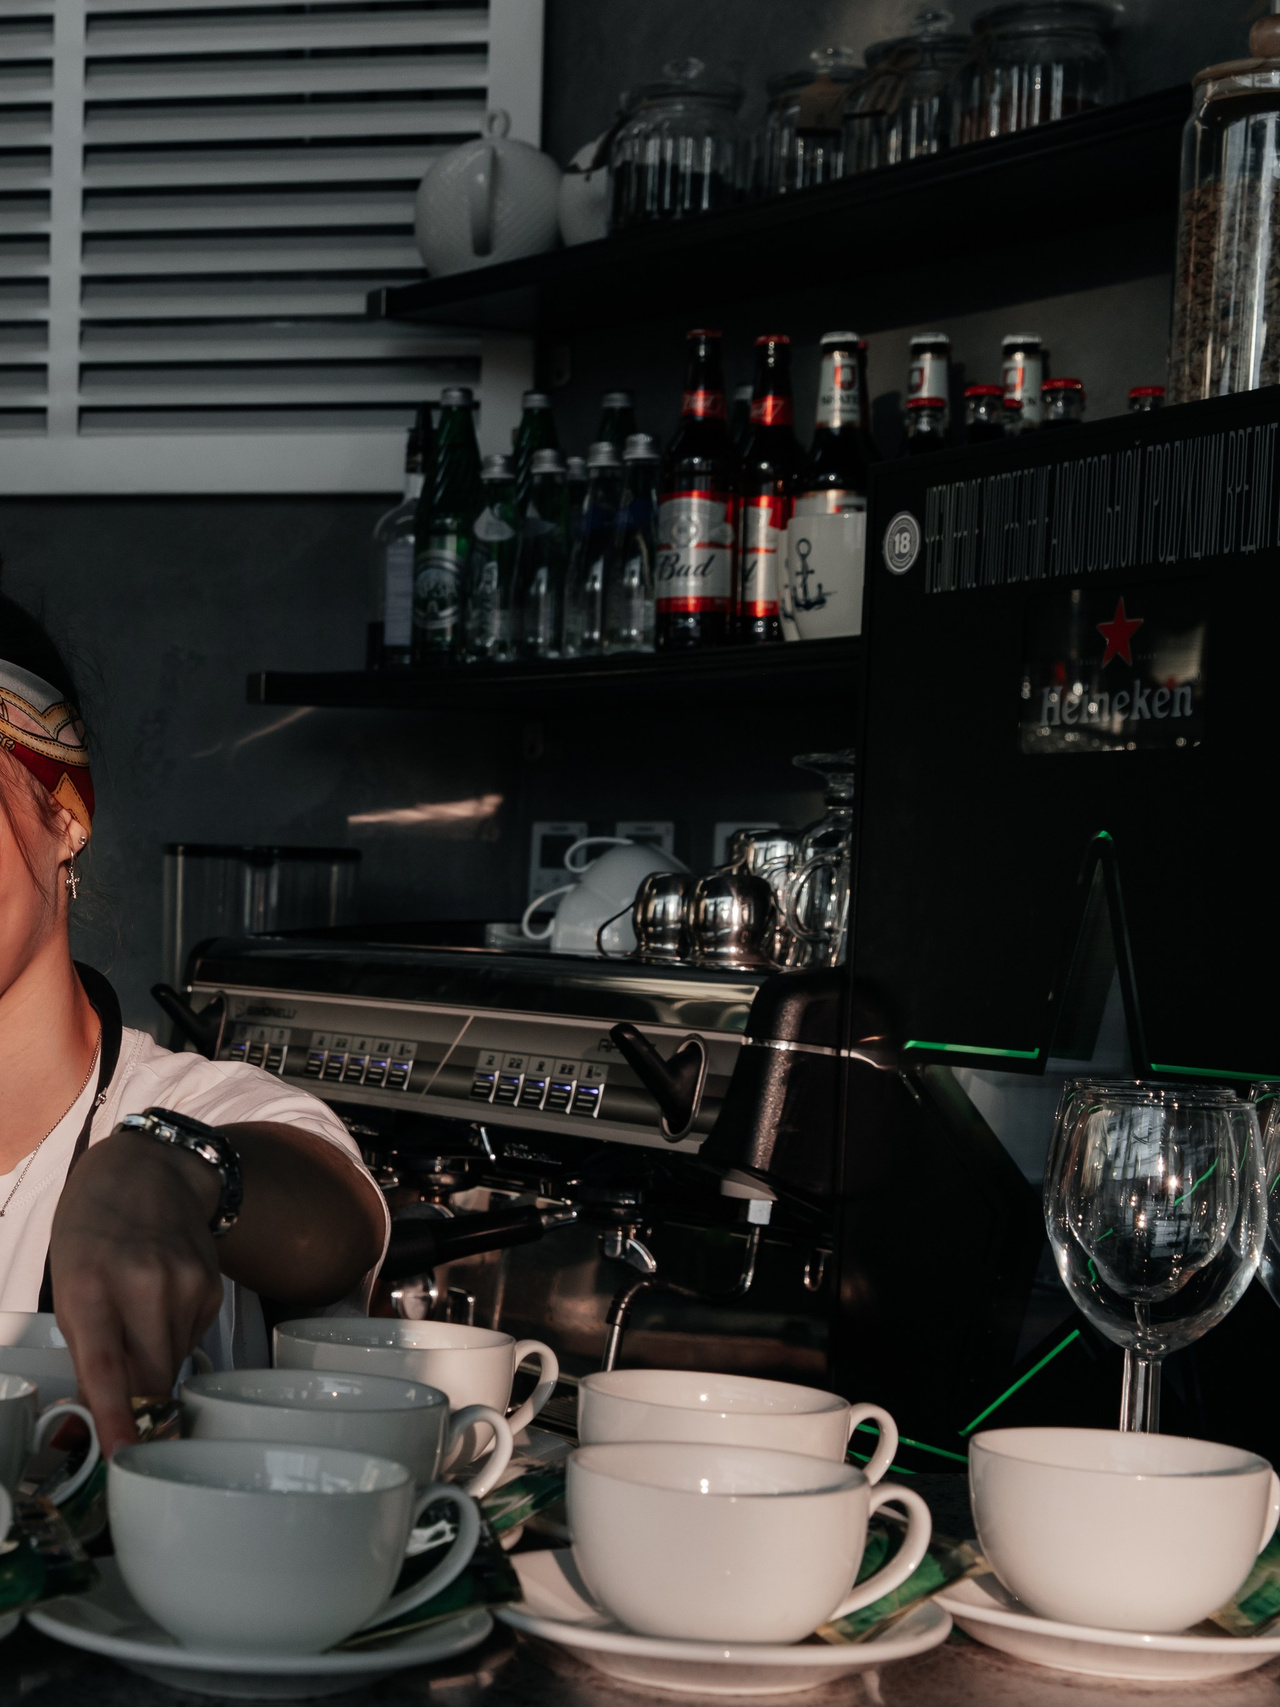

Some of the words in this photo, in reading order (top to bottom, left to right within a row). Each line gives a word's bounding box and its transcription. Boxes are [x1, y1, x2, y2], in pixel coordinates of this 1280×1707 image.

[1049, 440, 1142, 577] АЛКОГОЛЬНОЙ
[1141, 433, 1224, 565] ПРОДУКЦИИ
[1223, 422, 1278, 555] ВРЕДИТ
[894, 531, 911, 555] 18
[659, 552, 716, 581] Bud
[1039, 678, 1194, 727] Heineken
